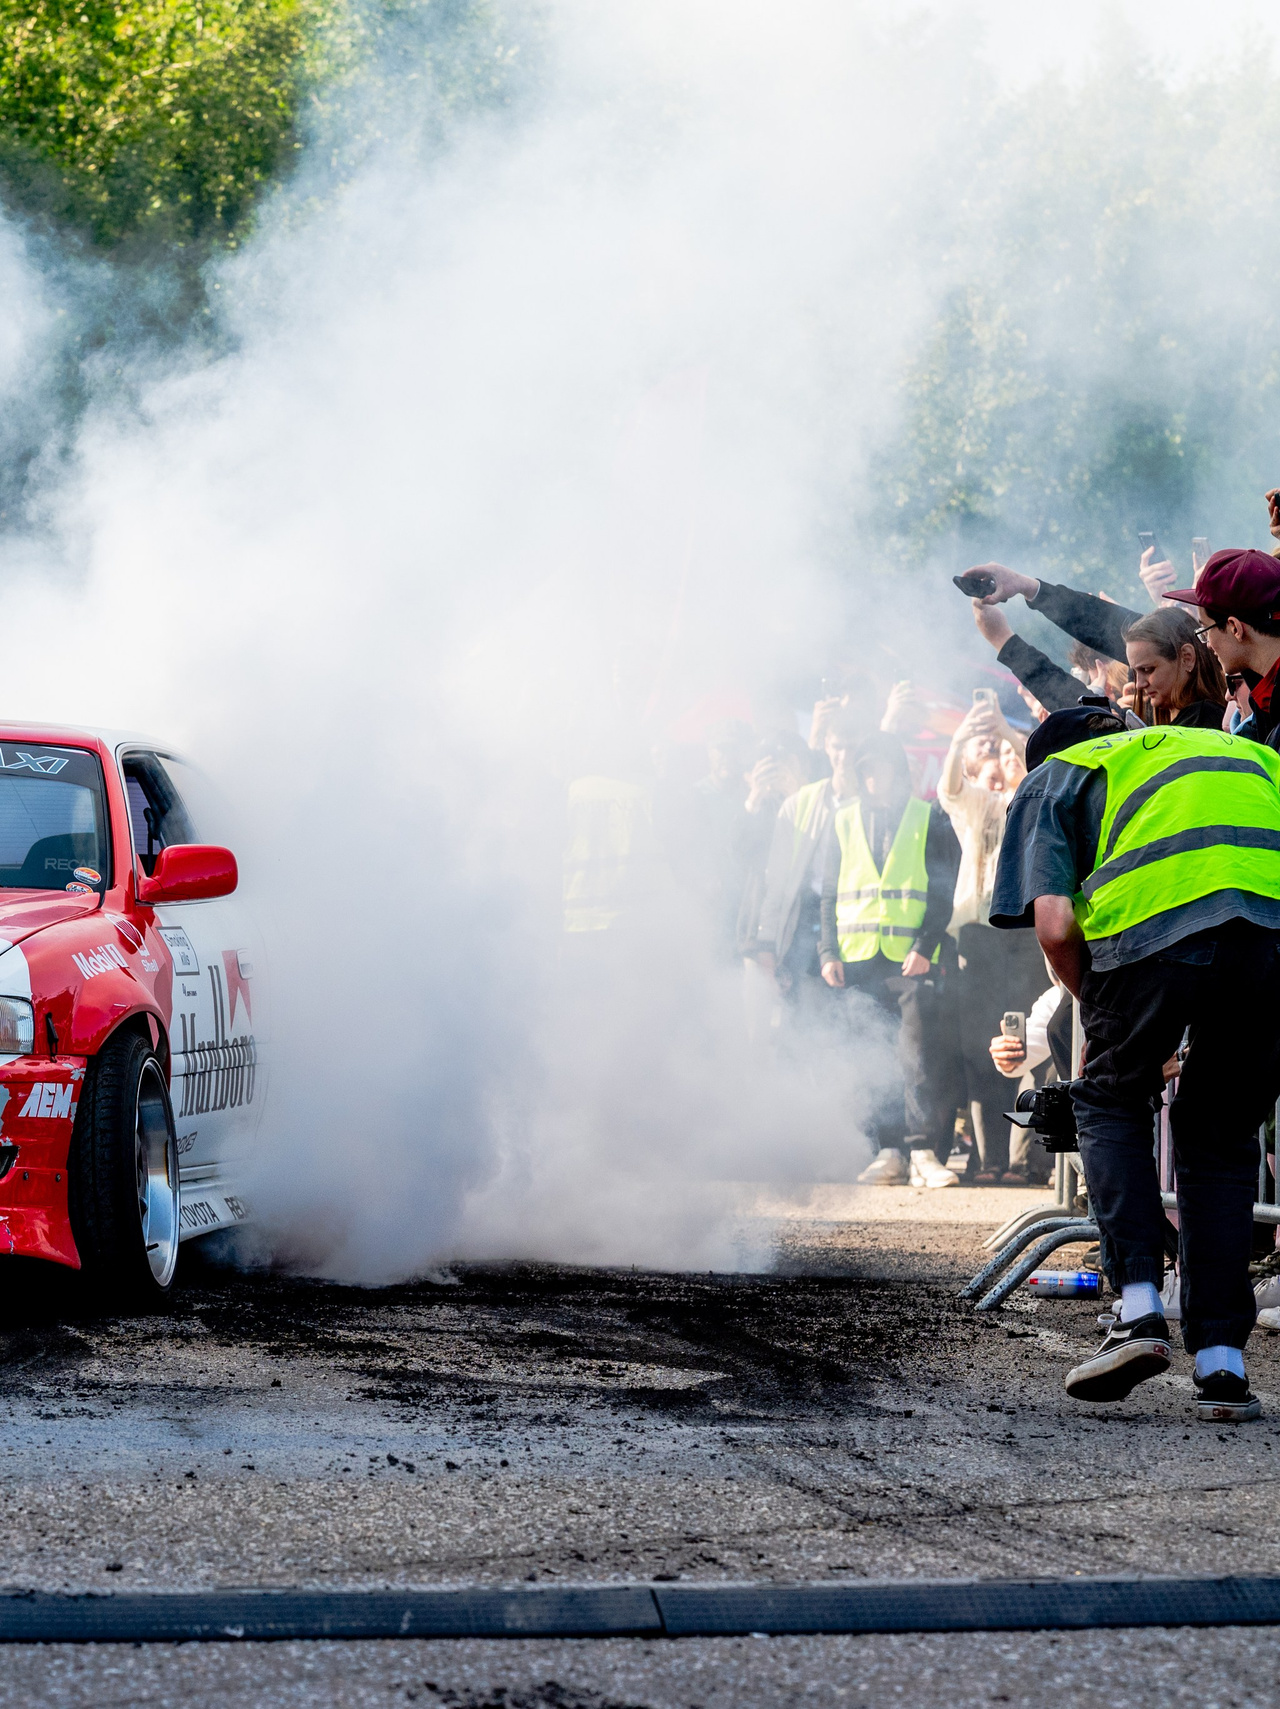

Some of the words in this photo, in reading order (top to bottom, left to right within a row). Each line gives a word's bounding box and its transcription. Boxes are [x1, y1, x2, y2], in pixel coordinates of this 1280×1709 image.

[72, 945, 118, 980] Mobil
[179, 965, 258, 1118] Marlboro
[18, 1082, 74, 1119] AEM
